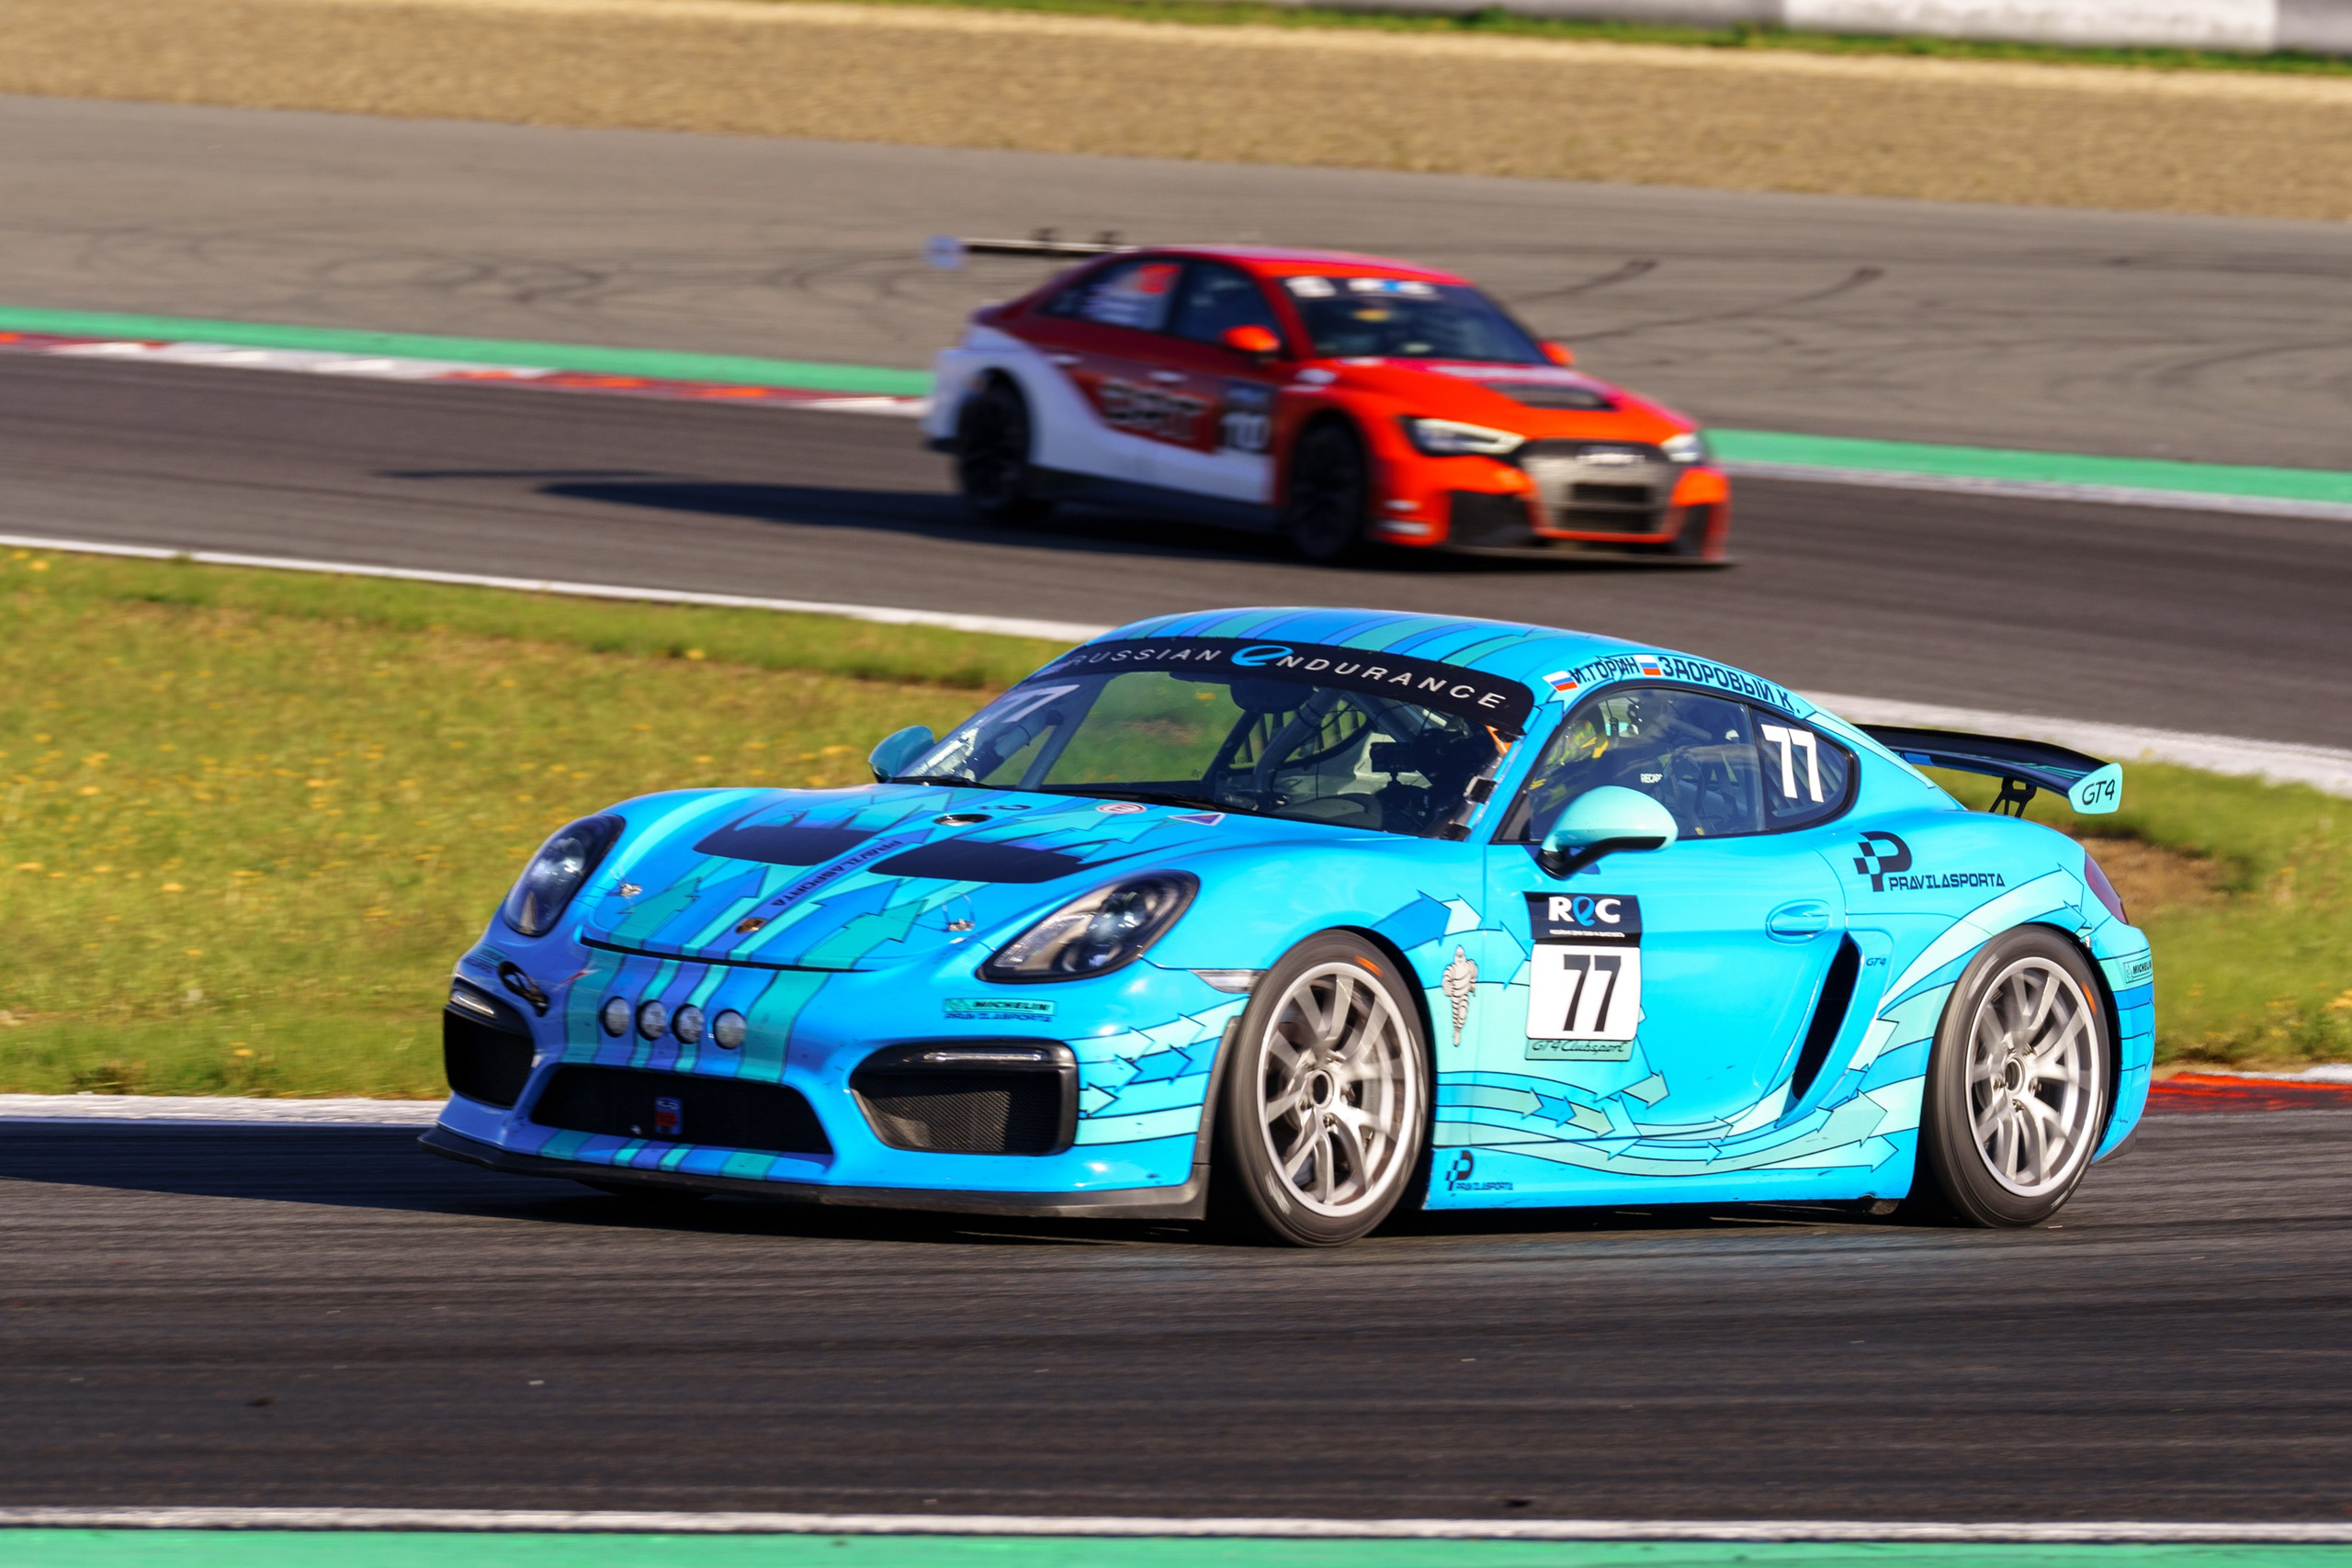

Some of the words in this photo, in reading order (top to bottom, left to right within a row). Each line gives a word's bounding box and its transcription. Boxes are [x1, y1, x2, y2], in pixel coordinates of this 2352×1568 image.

[1069, 648, 1222, 666] RUSSIAN
[1760, 724, 1825, 803] 77
[2081, 778, 2116, 807] GT4
[1889, 874, 2007, 891] PRAVILASPORTA
[1865, 957, 1887, 966] GT4
[1563, 953, 1622, 1032] 77
[1532, 1039, 1561, 1052] GT4
